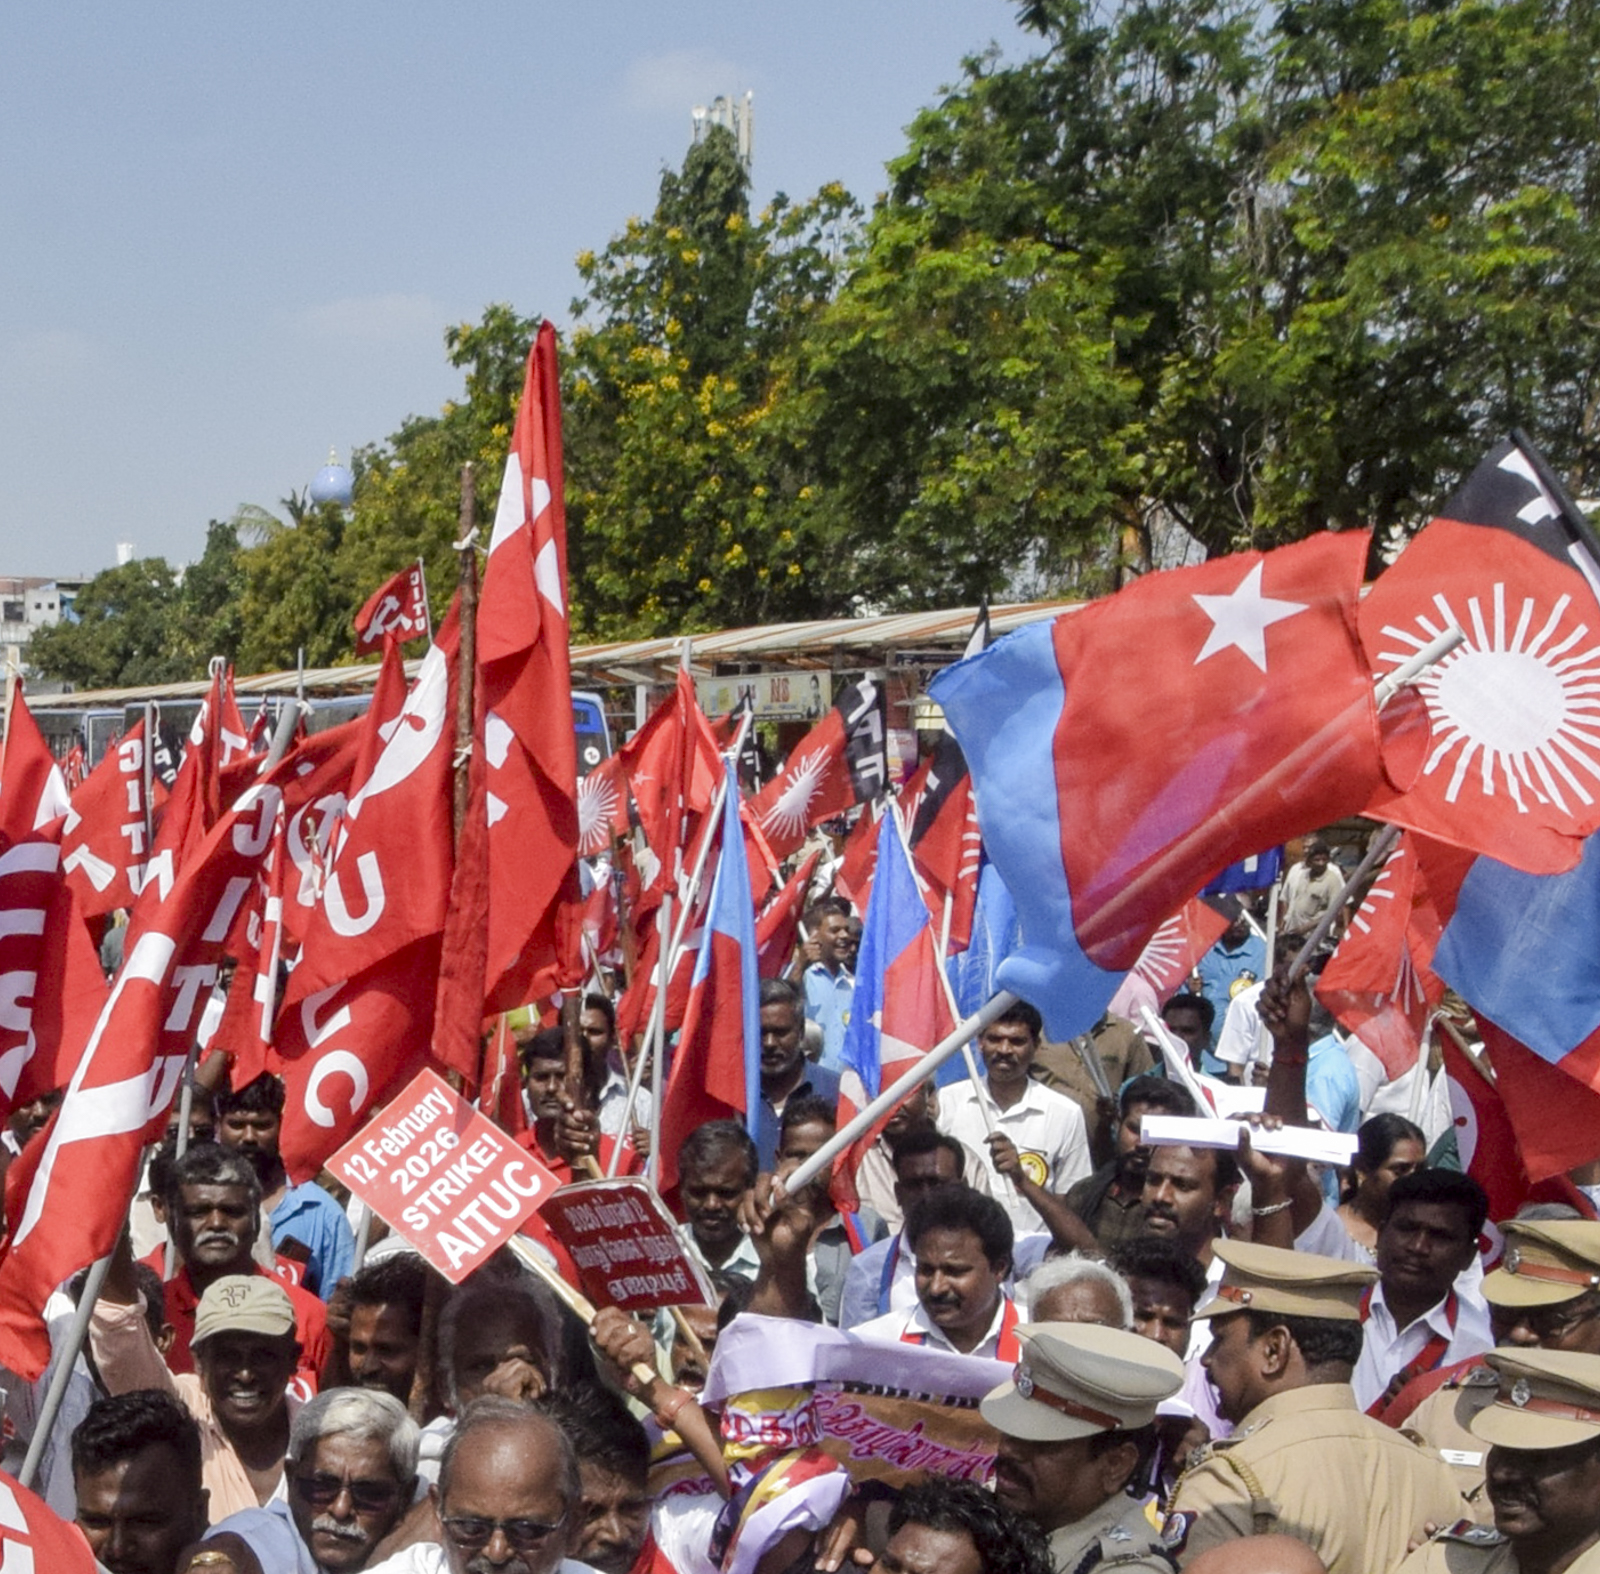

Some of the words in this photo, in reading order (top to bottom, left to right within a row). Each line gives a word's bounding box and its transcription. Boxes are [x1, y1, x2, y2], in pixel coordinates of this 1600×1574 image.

[770, 677, 790, 704] NS
[343, 1151, 378, 1186] 12
[363, 1086, 455, 1167] February
[389, 1125, 461, 1196] 2026
[401, 1132, 504, 1232] STRIKE!
[435, 1159, 542, 1270] AITUC
